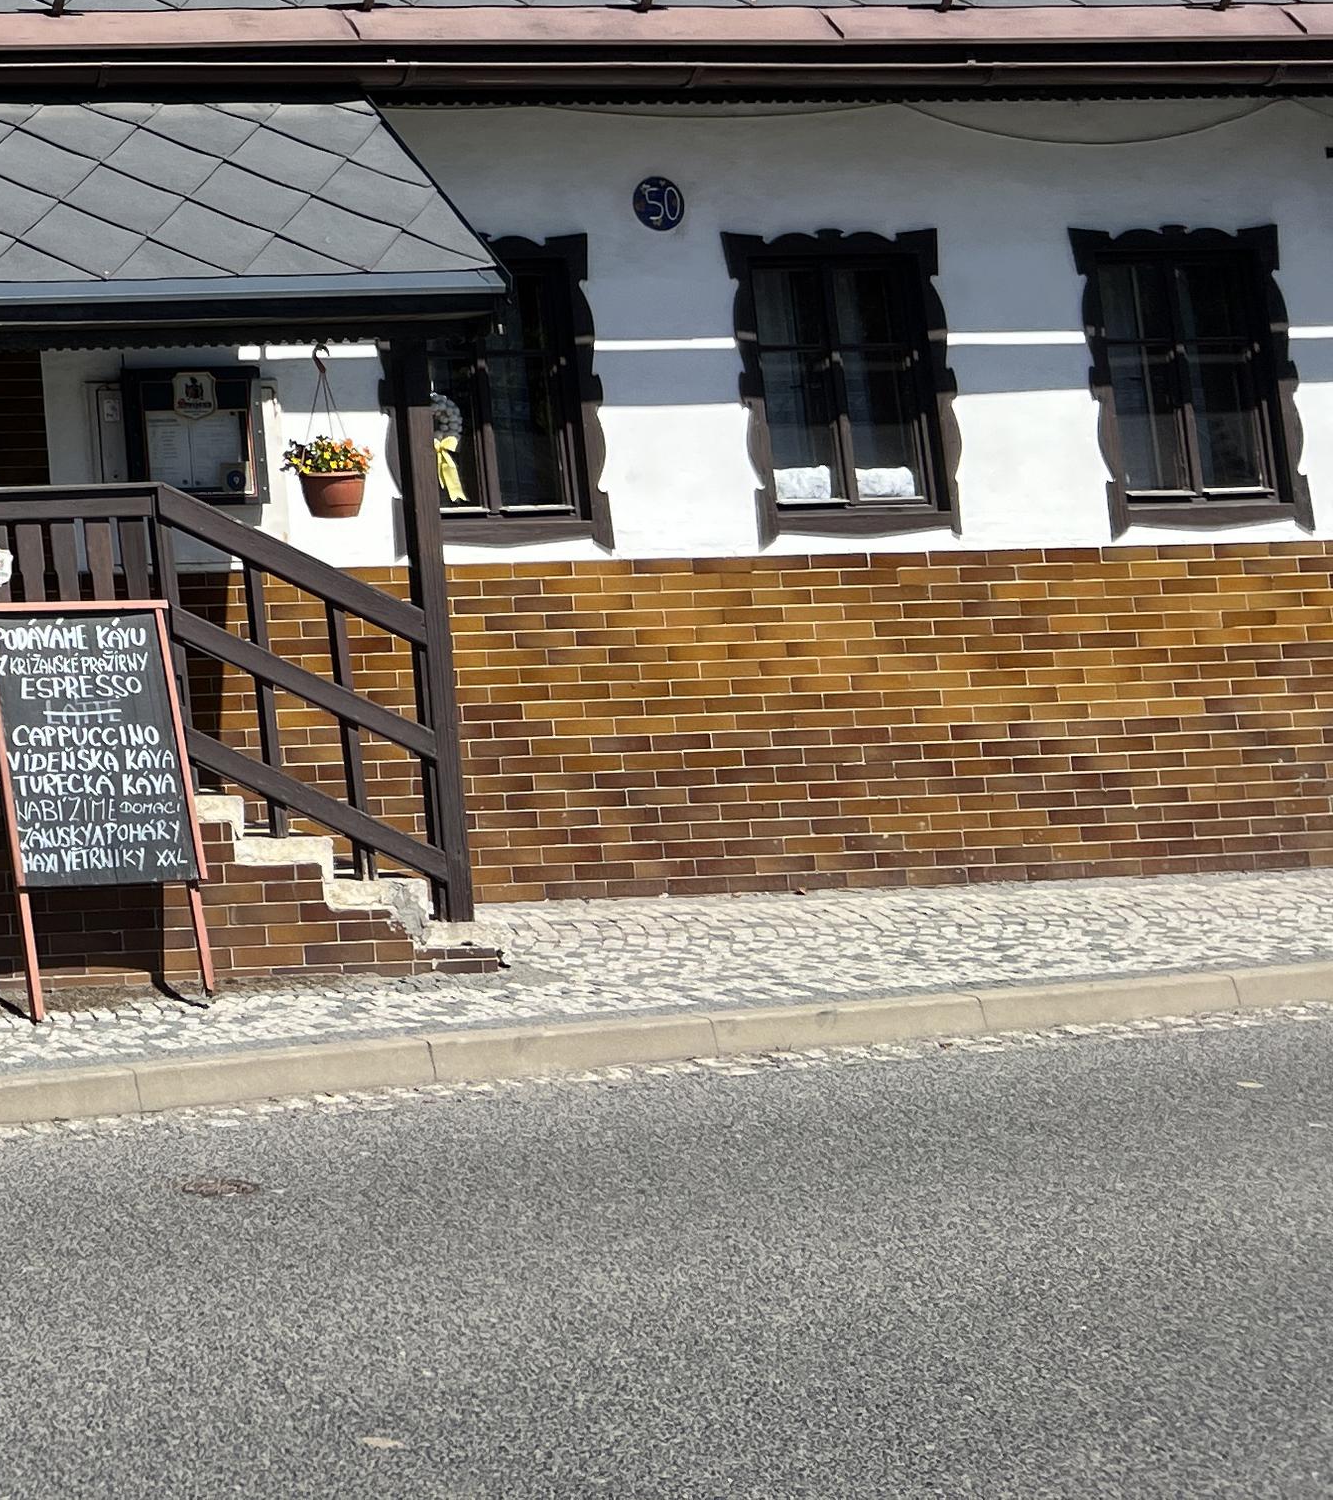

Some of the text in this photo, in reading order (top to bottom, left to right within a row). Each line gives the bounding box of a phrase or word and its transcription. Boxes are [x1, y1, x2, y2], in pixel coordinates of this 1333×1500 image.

[645, 187, 681, 220] 50
[96, 617, 146, 648] KÁVU
[80, 650, 148, 675] PRAŽÍRNY
[21, 674, 142, 699] ESPRESSO
[45, 699, 121, 725] LATTE
[12, 723, 160, 747] CAPPUCCINO
[125, 745, 175, 771] KÁVA
[13, 771, 176, 797] TURECKÁ KÁVA
[15, 796, 117, 822] NABÍZÍME
[17, 819, 180, 851] ZÁKUSKY A POHÁRY
[20, 851, 58, 873] MAXI
[156, 848, 188, 867] XXL
